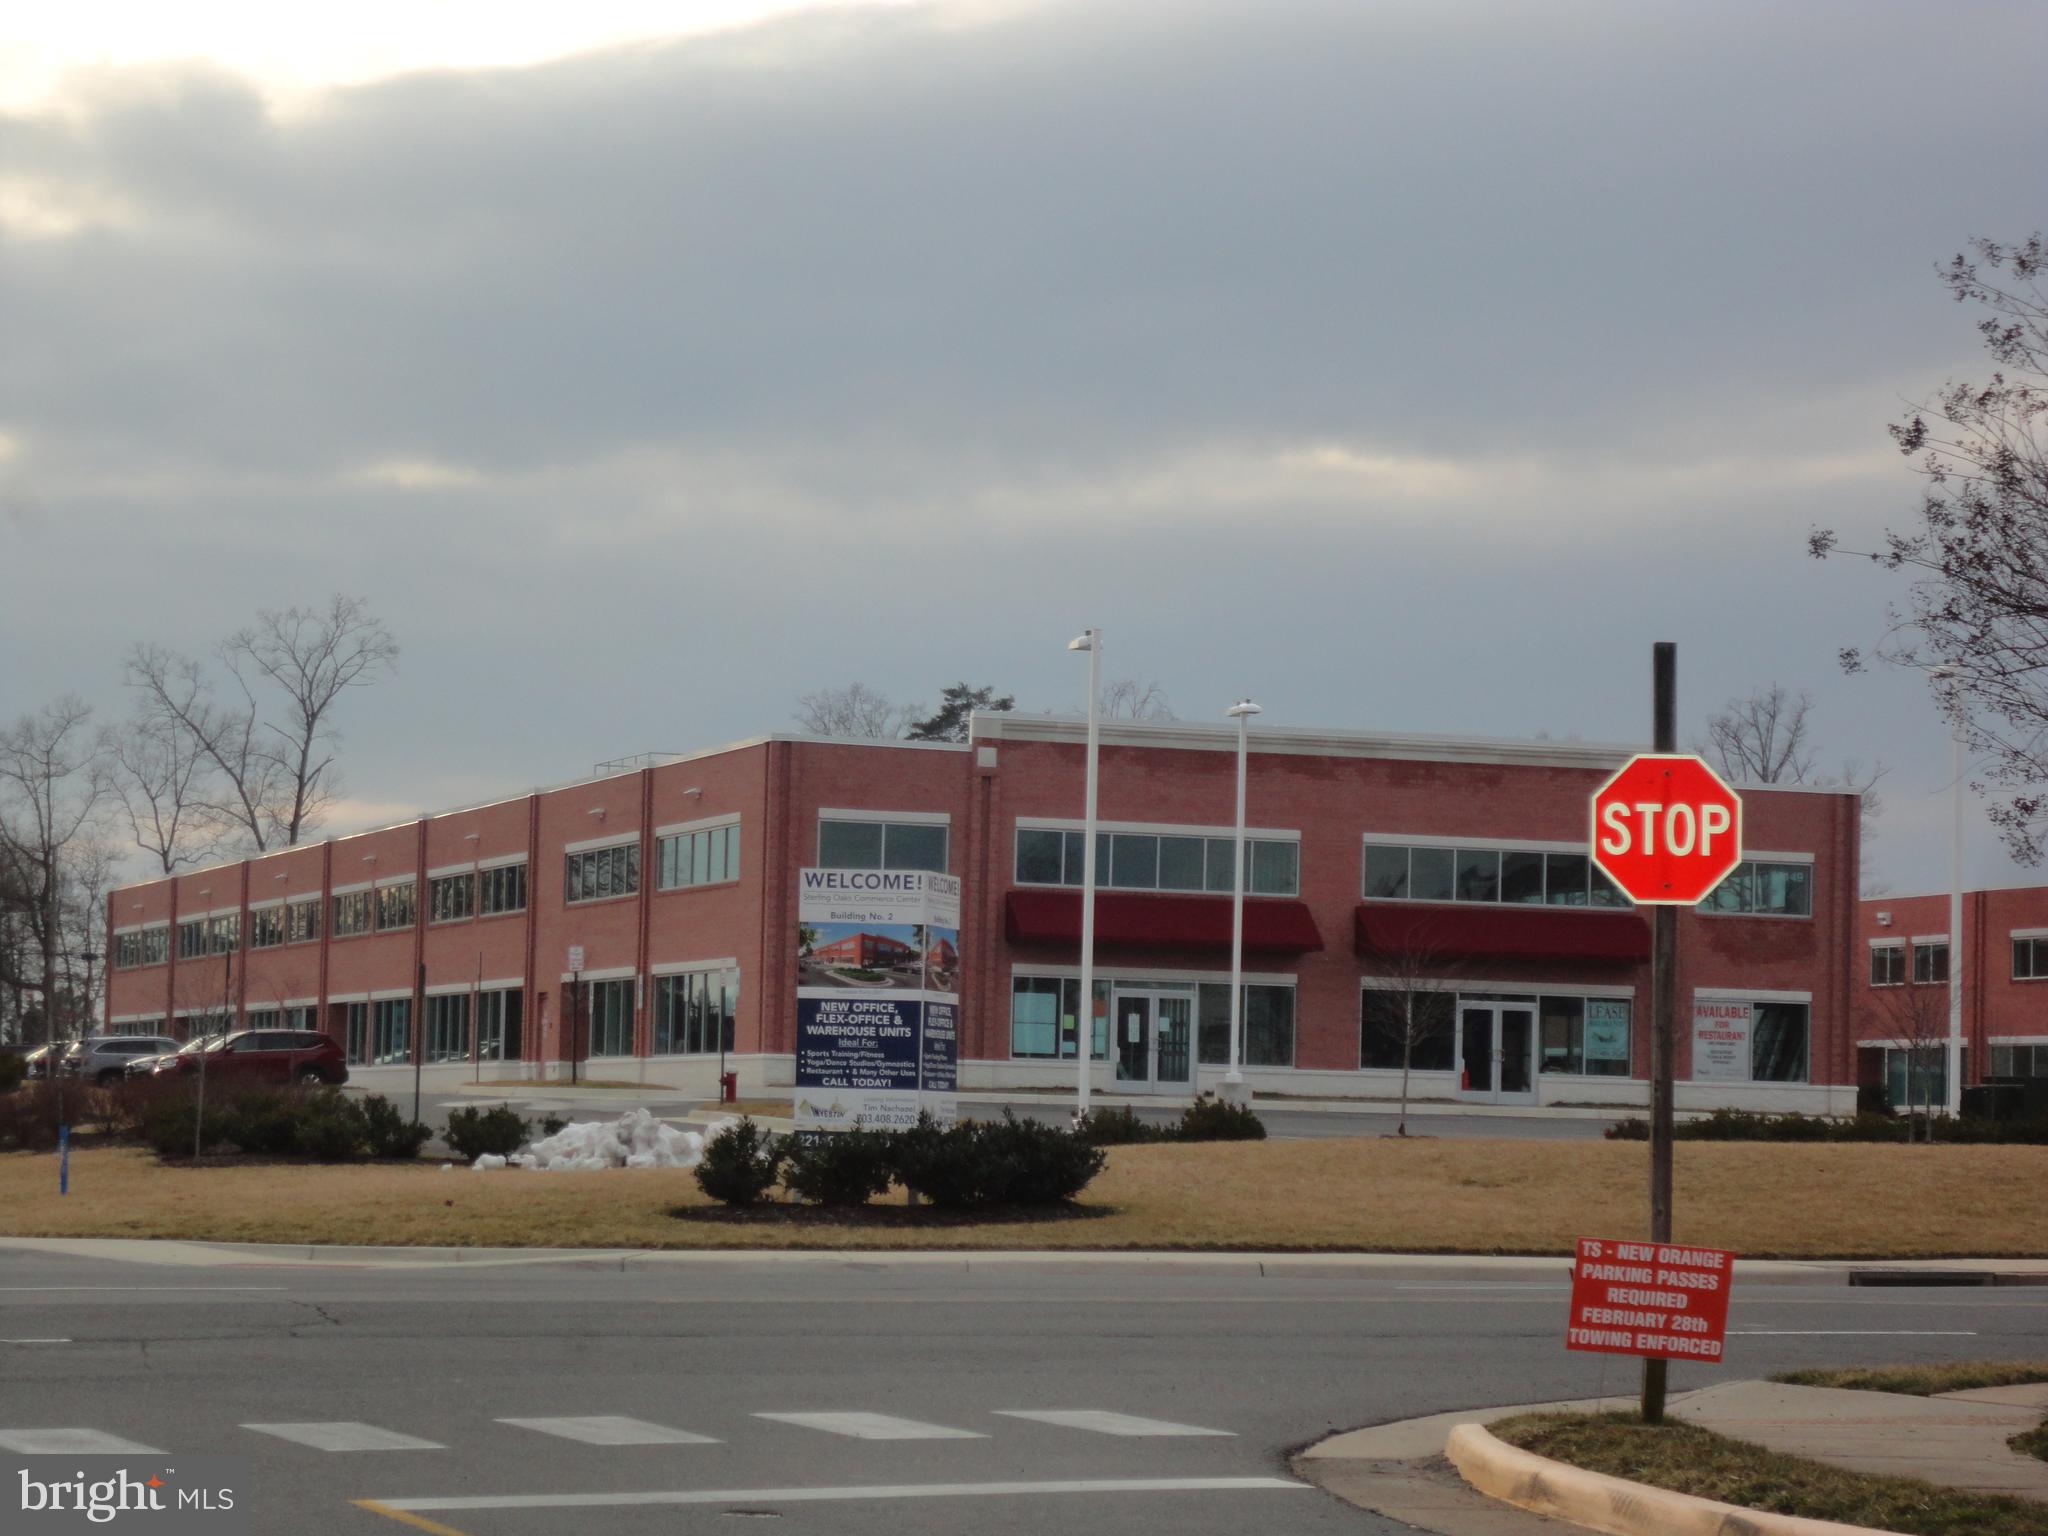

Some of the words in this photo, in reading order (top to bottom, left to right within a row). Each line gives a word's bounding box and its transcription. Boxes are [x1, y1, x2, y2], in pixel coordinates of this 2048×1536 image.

[1602, 802, 1731, 857] STOP
[804, 872, 923, 890] WELCOME!
[830, 911, 866, 922] Building
[869, 912, 884, 921] No.
[888, 912, 894, 921] 2
[821, 1002, 849, 1013] NEW
[853, 1003, 898, 1014] OFFICE,
[1696, 1006, 1750, 1018] AVAILABLE
[816, 1014, 890, 1025] FLEX-OFFICE
[894, 1015, 903, 1025] &
[806, 1026, 876, 1037] WAREHOUSE
[879, 1027, 911, 1038] UNITS
[1697, 1030, 1746, 1041] RESTAURANT
[838, 1038, 860, 1047] Ideal
[862, 1039, 878, 1048] For:
[806, 1050, 830, 1059] Sports
[832, 1050, 885, 1059] Training/Fitness
[806, 1059, 847, 1067] Yoga/Dance
[806, 1067, 843, 1075] Restaurant
[860, 1069, 877, 1077] Many
[879, 1069, 899, 1077] Other
[822, 1077, 849, 1087] CALL
[852, 1078, 891, 1088] TODAY!
[1581, 1241, 1602, 1258] TS
[1617, 1244, 1655, 1262] NEW
[1657, 1247, 1724, 1269] ORANGE
[1581, 1263, 1653, 1284] PARKING
[1656, 1269, 1719, 1291] PASSES
[1607, 1287, 1689, 1309] REQUIRED
[1581, 1307, 1668, 1329] FEBRUARY
[1671, 1315, 1709, 1333] 28th
[1569, 1328, 1633, 1348] TOWING
[1635, 1333, 1722, 1356] ENFORCED
